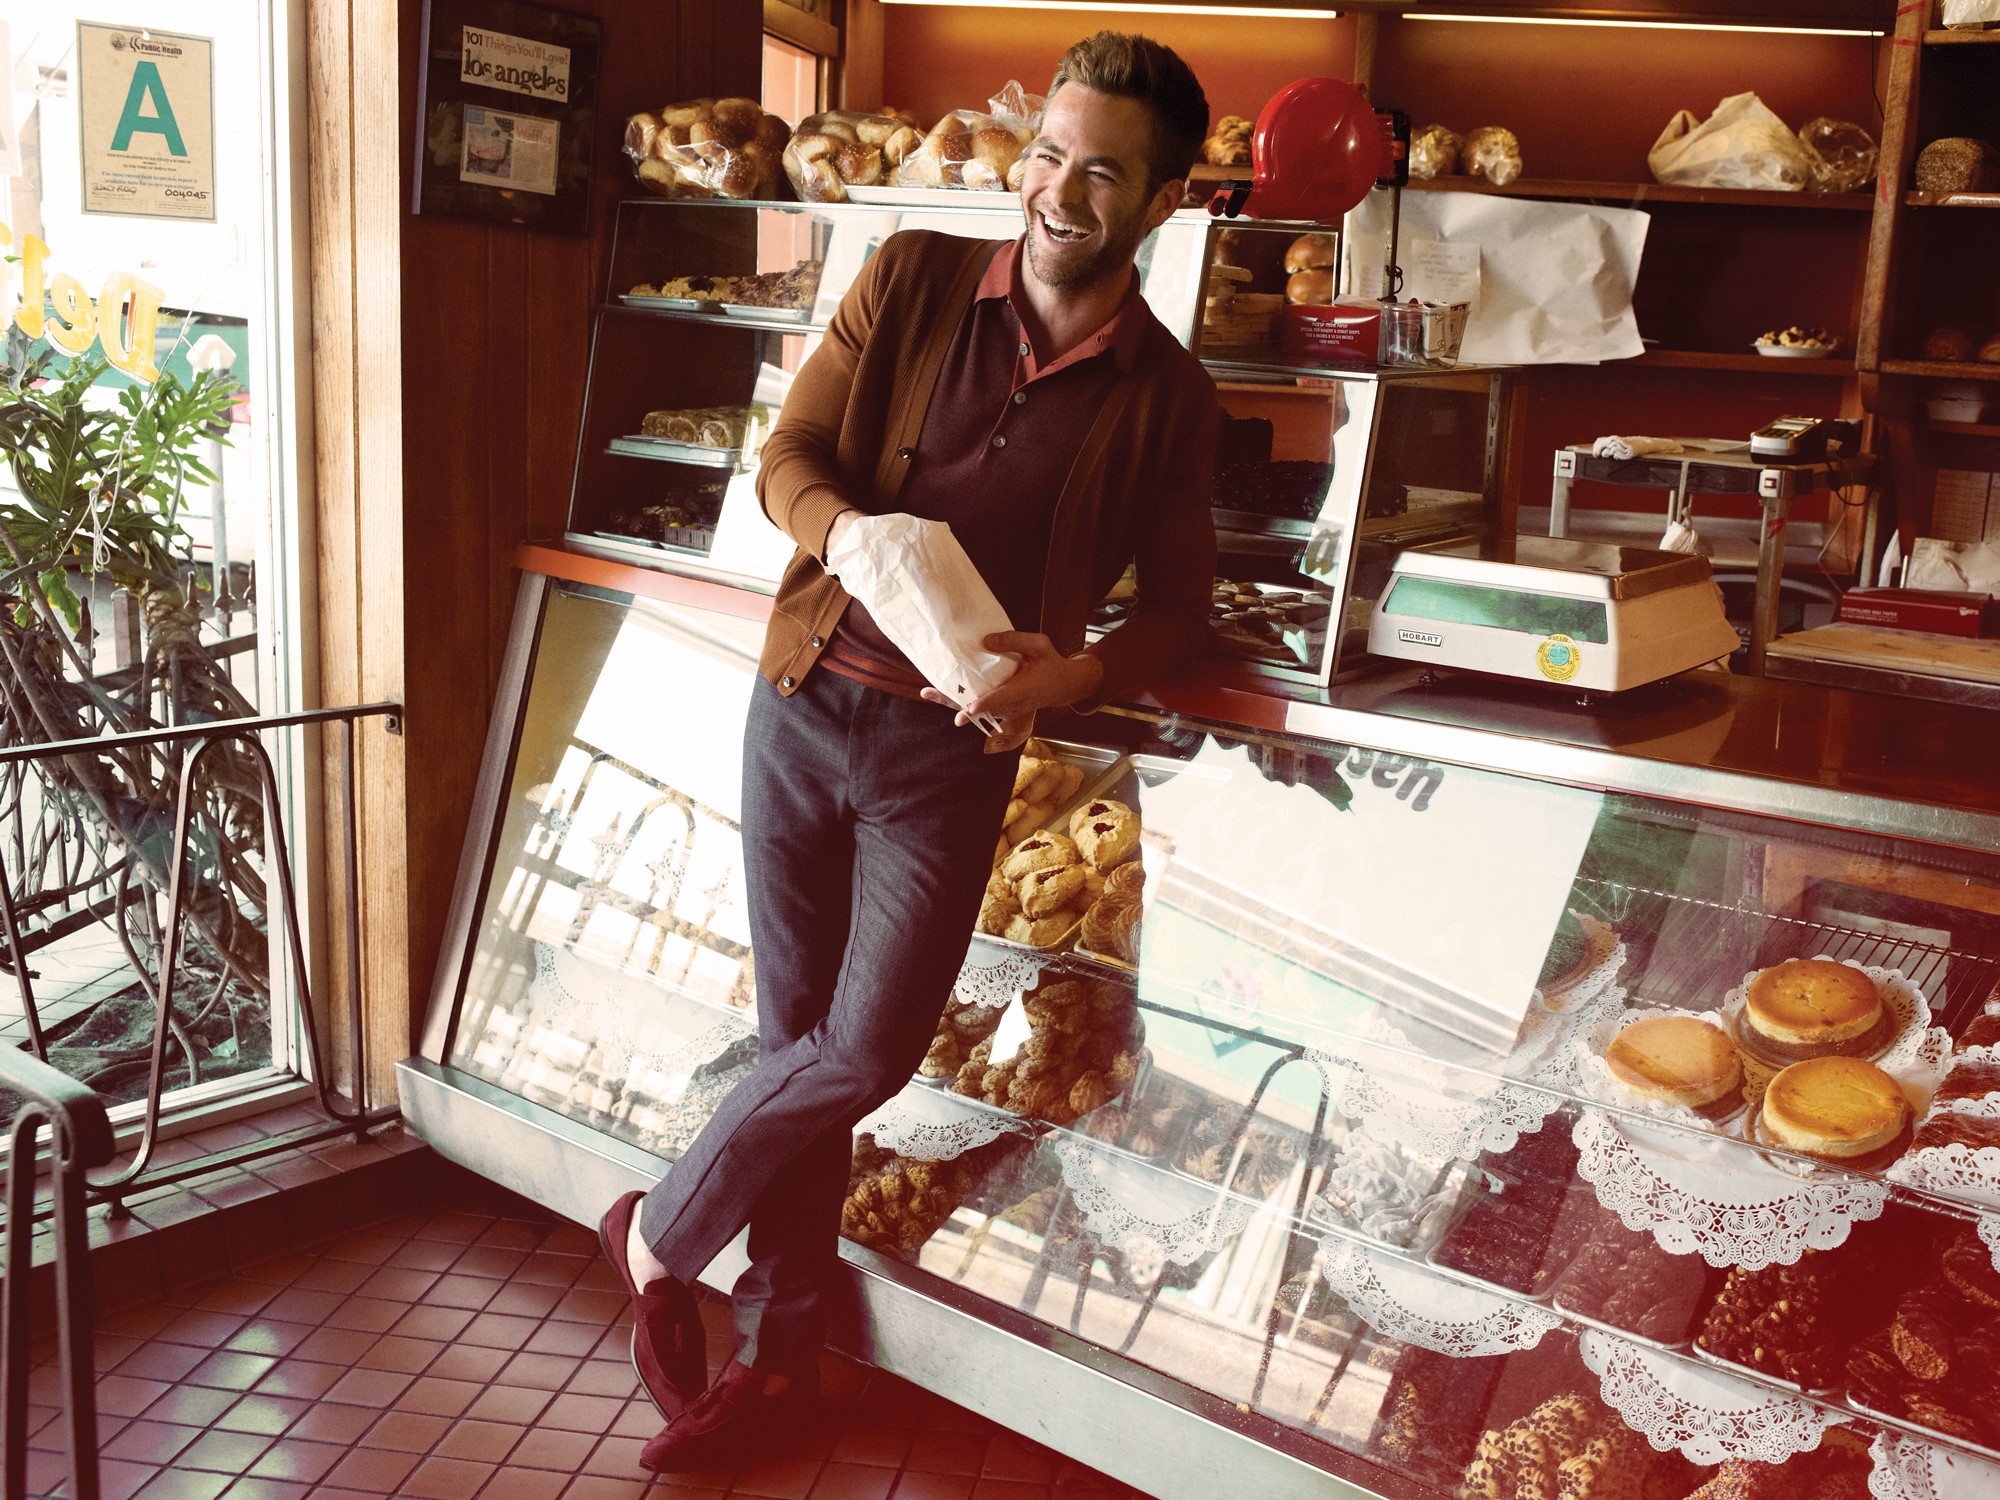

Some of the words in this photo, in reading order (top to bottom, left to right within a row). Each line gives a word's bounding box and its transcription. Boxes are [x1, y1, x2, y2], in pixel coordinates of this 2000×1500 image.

[141, 43, 161, 52] Public
[162, 46, 183, 55] Health
[466, 31, 482, 46] 101
[484, 36, 516, 56] Things
[517, 43, 541, 59] You'll
[542, 49, 568, 65] Love!
[463, 48, 492, 81] los
[495, 65, 566, 94] angeles
[111, 60, 188, 157] A
[1402, 632, 1439, 643] HOBART
